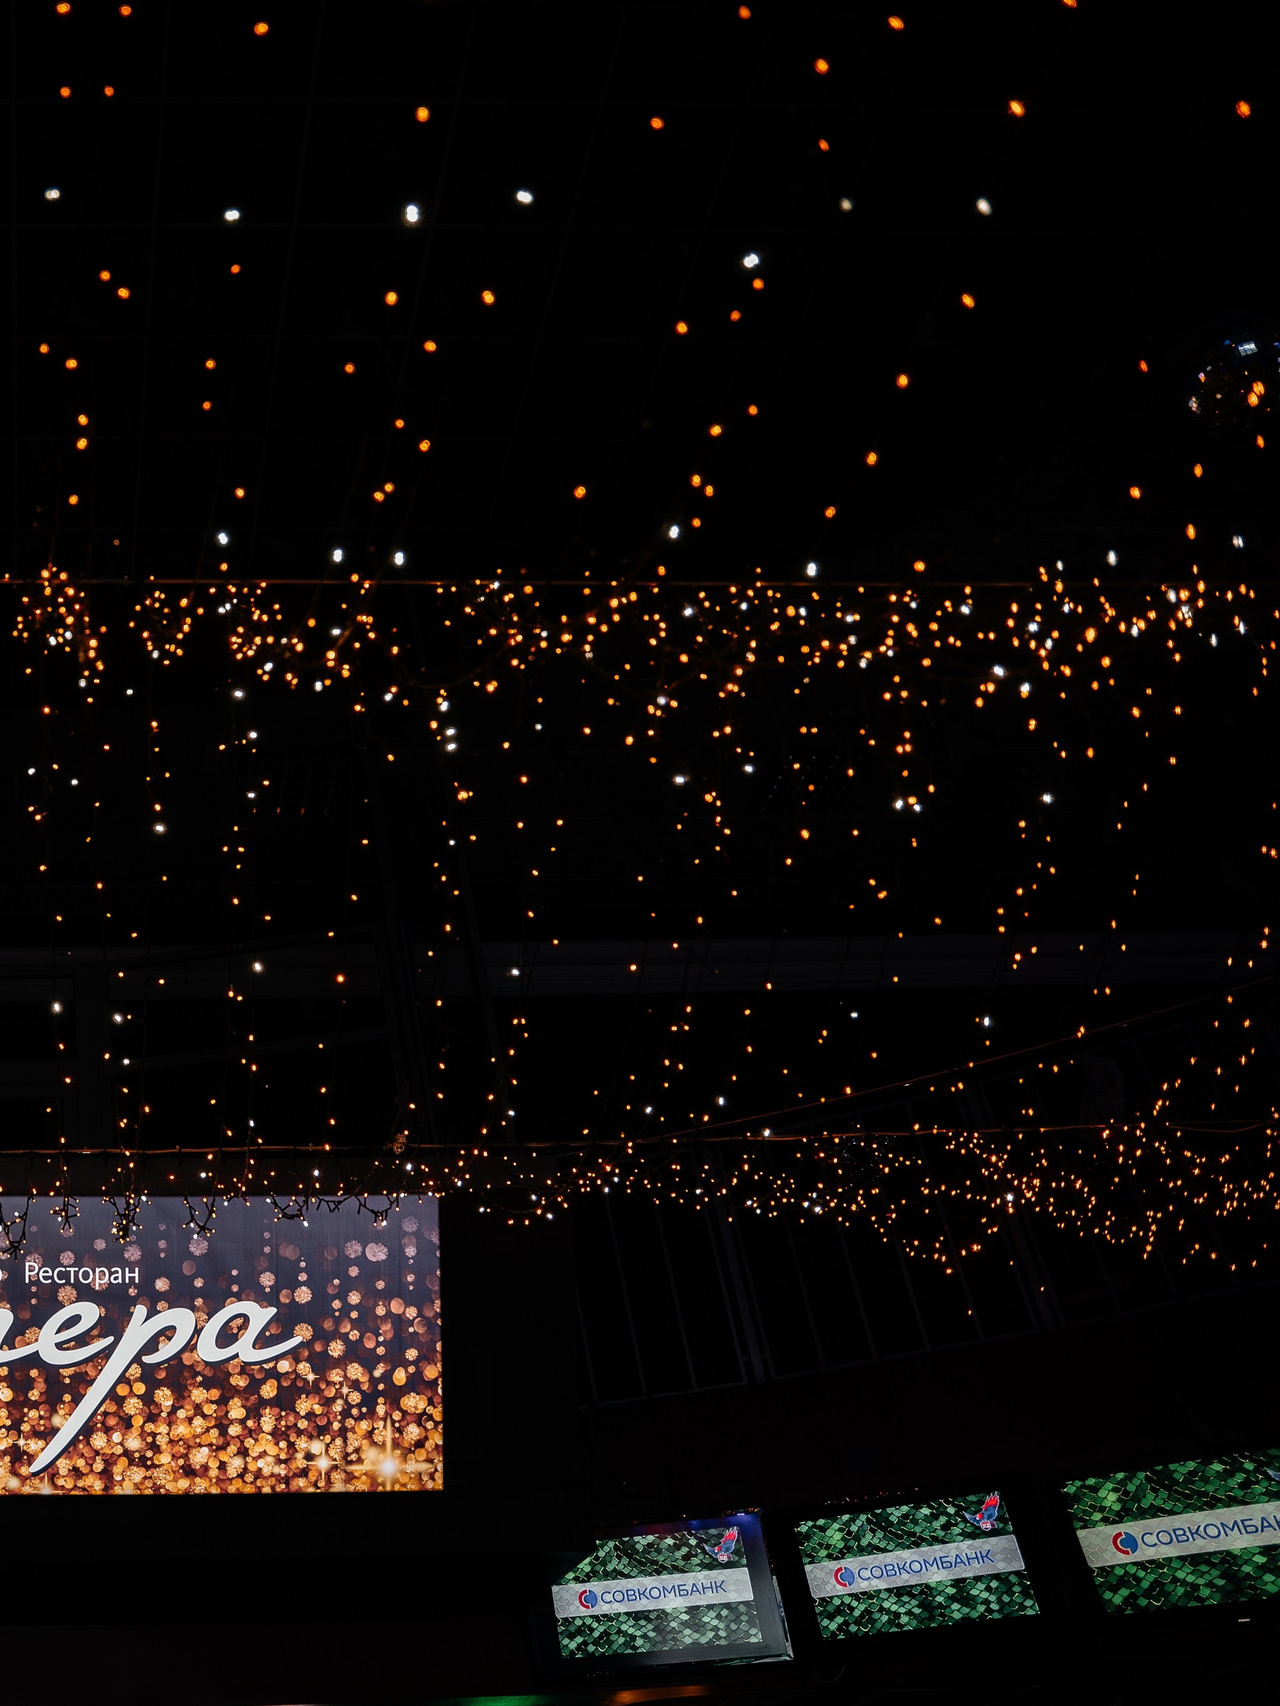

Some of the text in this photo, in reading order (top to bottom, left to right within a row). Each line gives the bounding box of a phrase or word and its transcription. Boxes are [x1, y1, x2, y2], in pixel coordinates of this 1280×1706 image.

[24, 1261, 139, 1291] Ресторан
[857, 1549, 995, 1582] СОВКОМБАНК
[600, 1579, 728, 1605] СОВКОМБАНК
